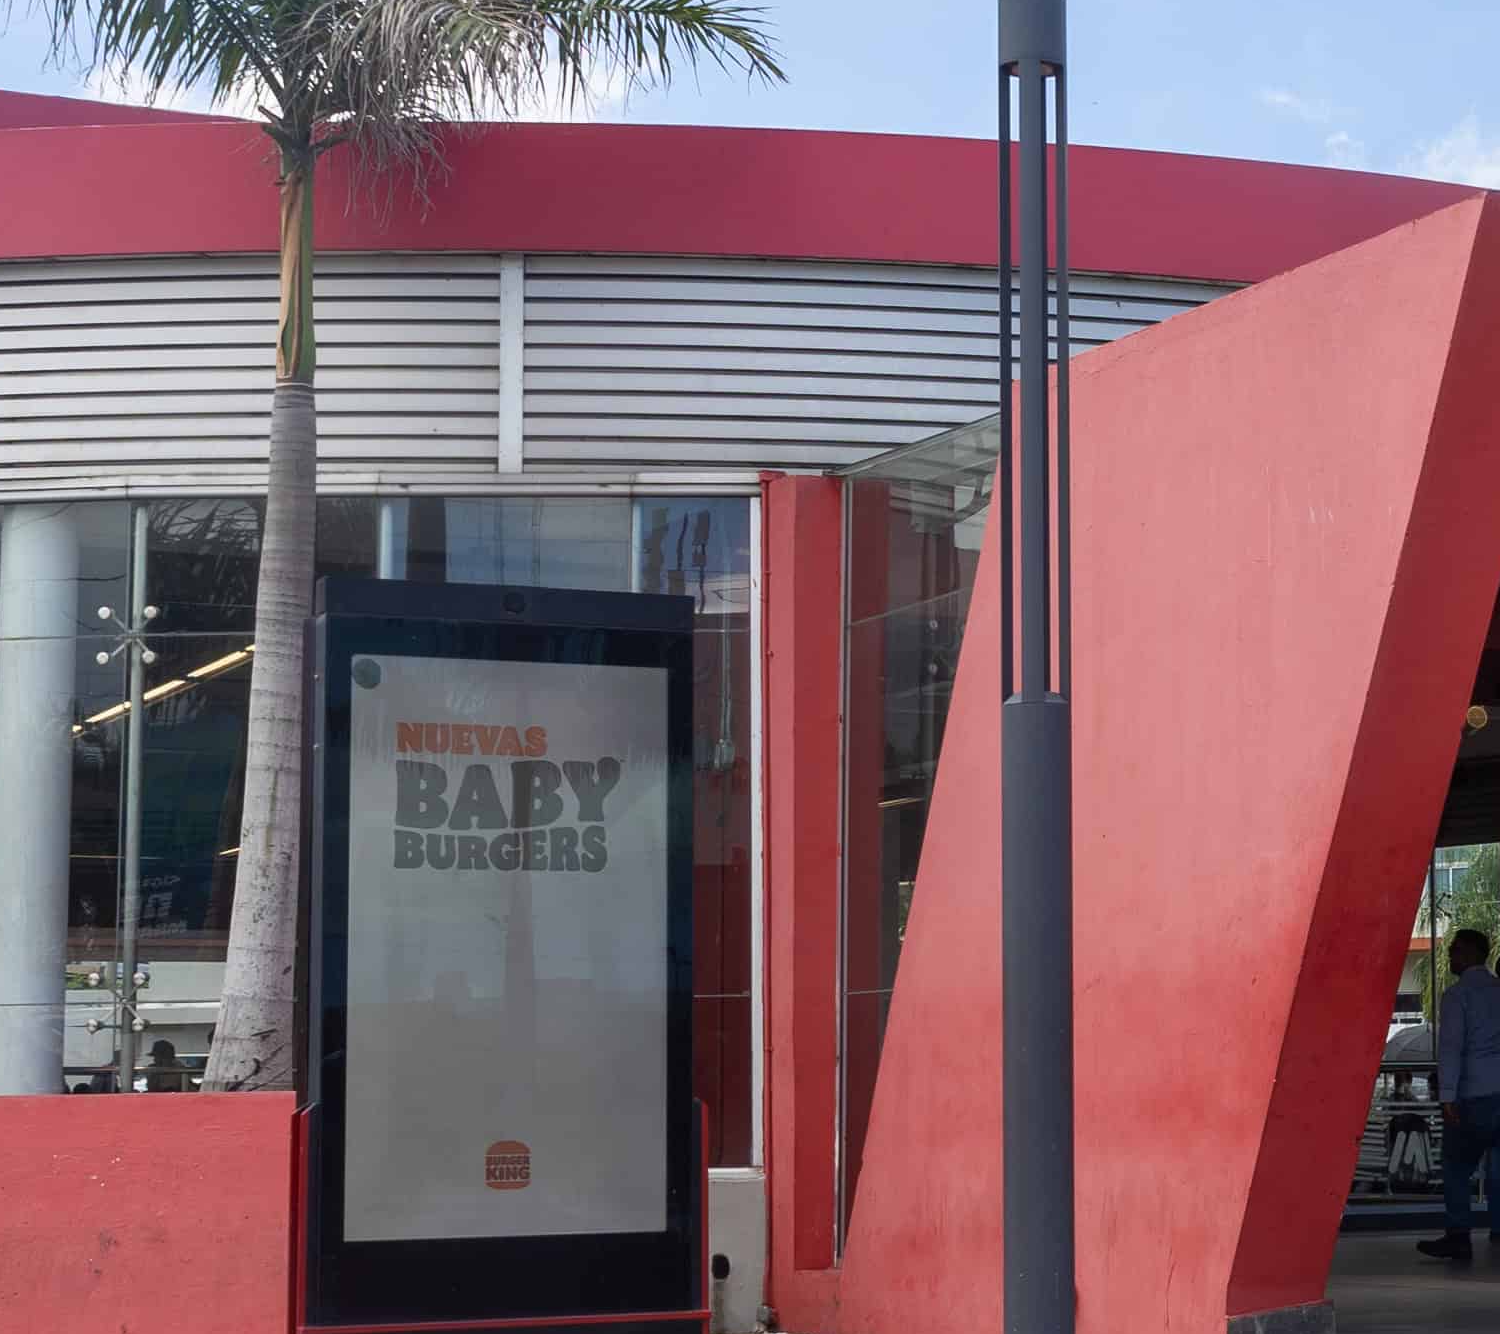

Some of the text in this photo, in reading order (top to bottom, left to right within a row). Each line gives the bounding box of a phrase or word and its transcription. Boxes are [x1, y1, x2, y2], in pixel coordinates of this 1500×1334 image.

[395, 722, 549, 757] NUEVAS
[395, 756, 621, 831] BABY
[393, 825, 608, 873] BURGERS
[486, 1166, 530, 1180] KING
